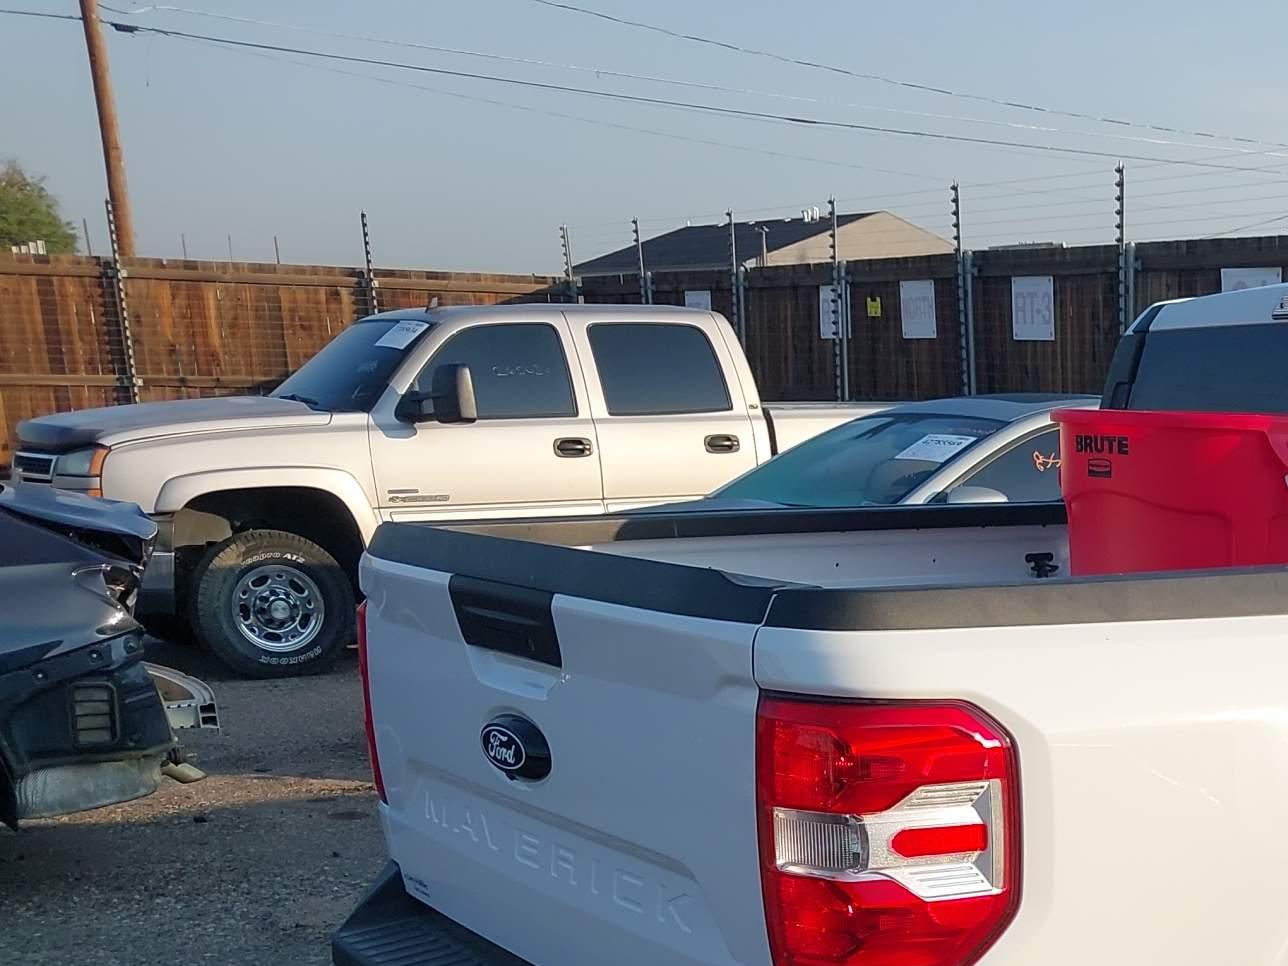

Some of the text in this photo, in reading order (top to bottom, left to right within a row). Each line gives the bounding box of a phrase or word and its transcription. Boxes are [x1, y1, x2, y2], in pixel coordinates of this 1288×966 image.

[1015, 291, 1050, 325] RT-3
[1075, 434, 1129, 455] BRUTE
[487, 730, 516, 764] Ford
[424, 786, 692, 934] MAVERICK
